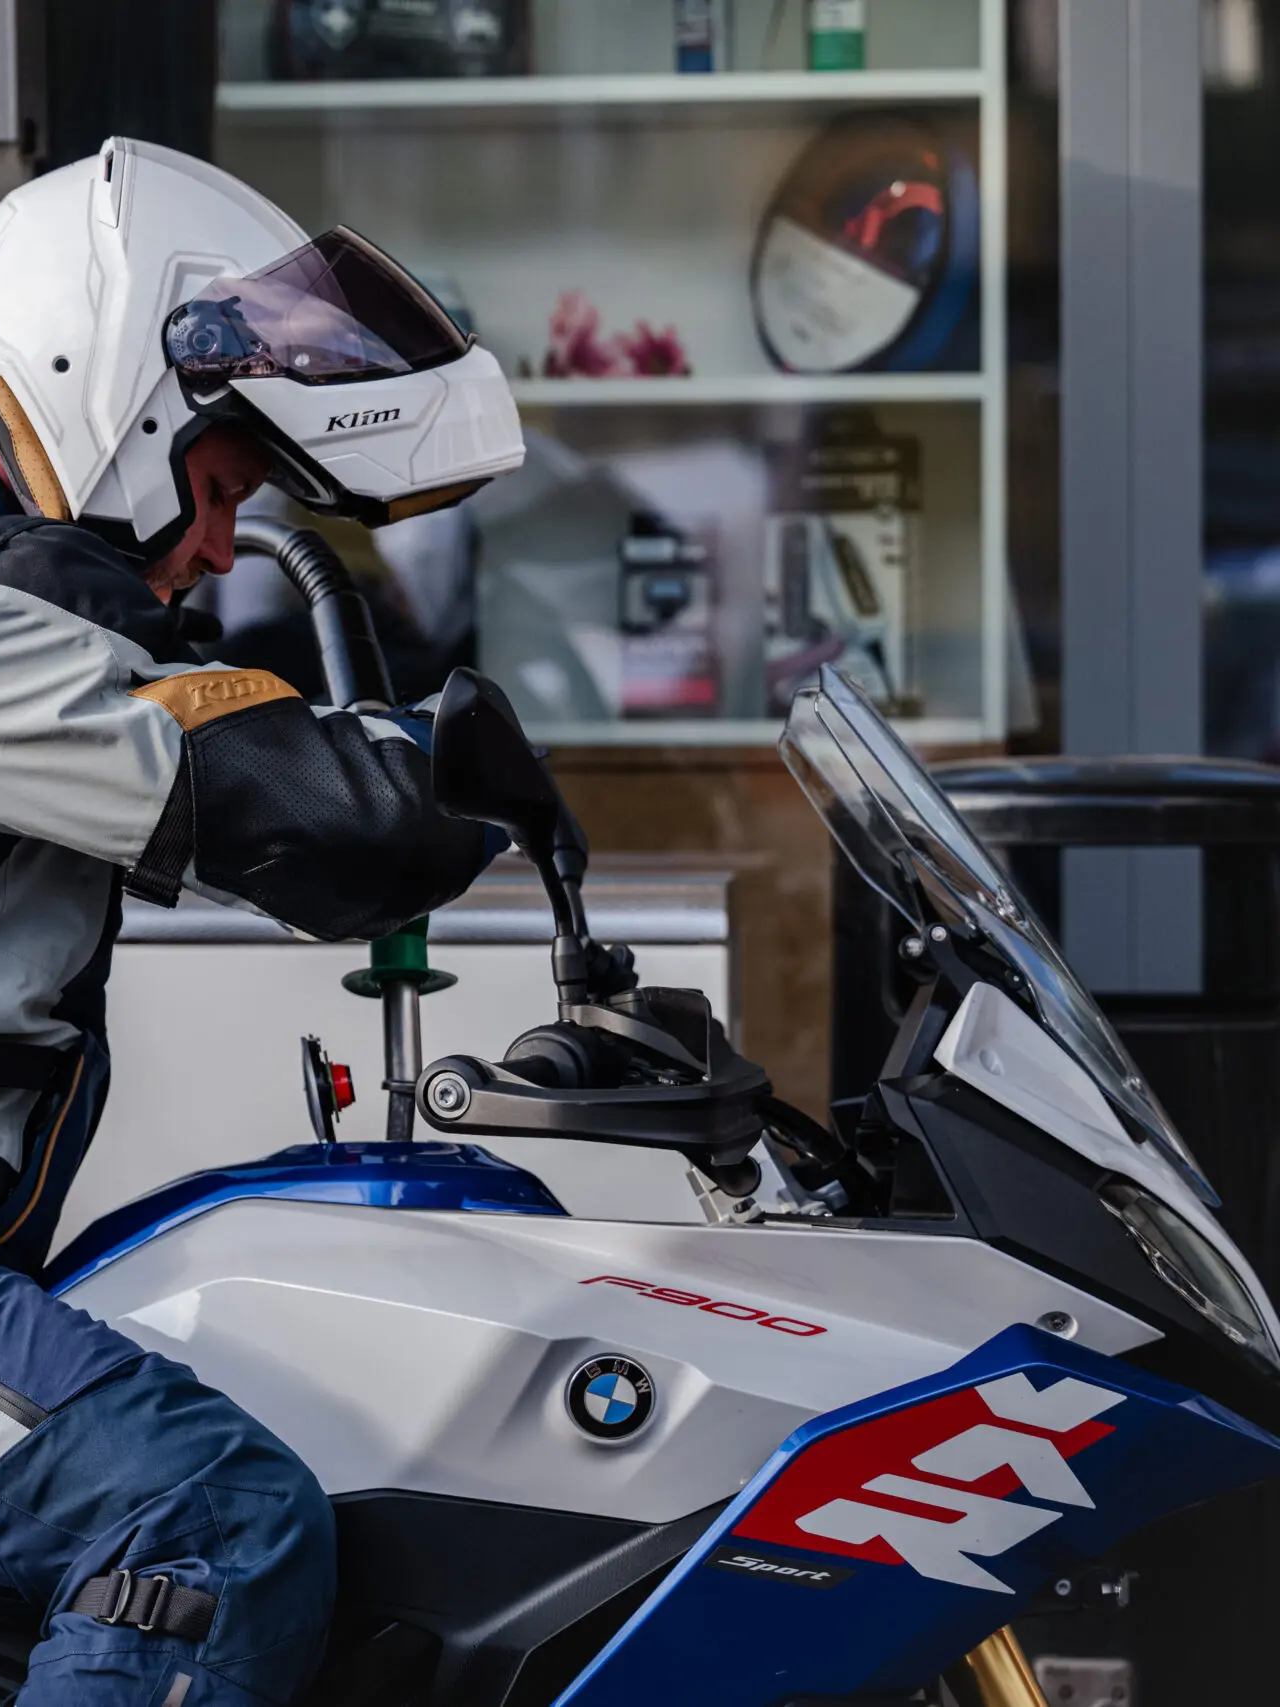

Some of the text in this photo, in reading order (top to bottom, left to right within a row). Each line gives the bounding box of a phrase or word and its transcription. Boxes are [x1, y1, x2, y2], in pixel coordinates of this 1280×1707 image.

[577, 1275, 828, 1337] F900
[584, 1359, 651, 1395] BMW
[718, 1555, 831, 1580] Sport
